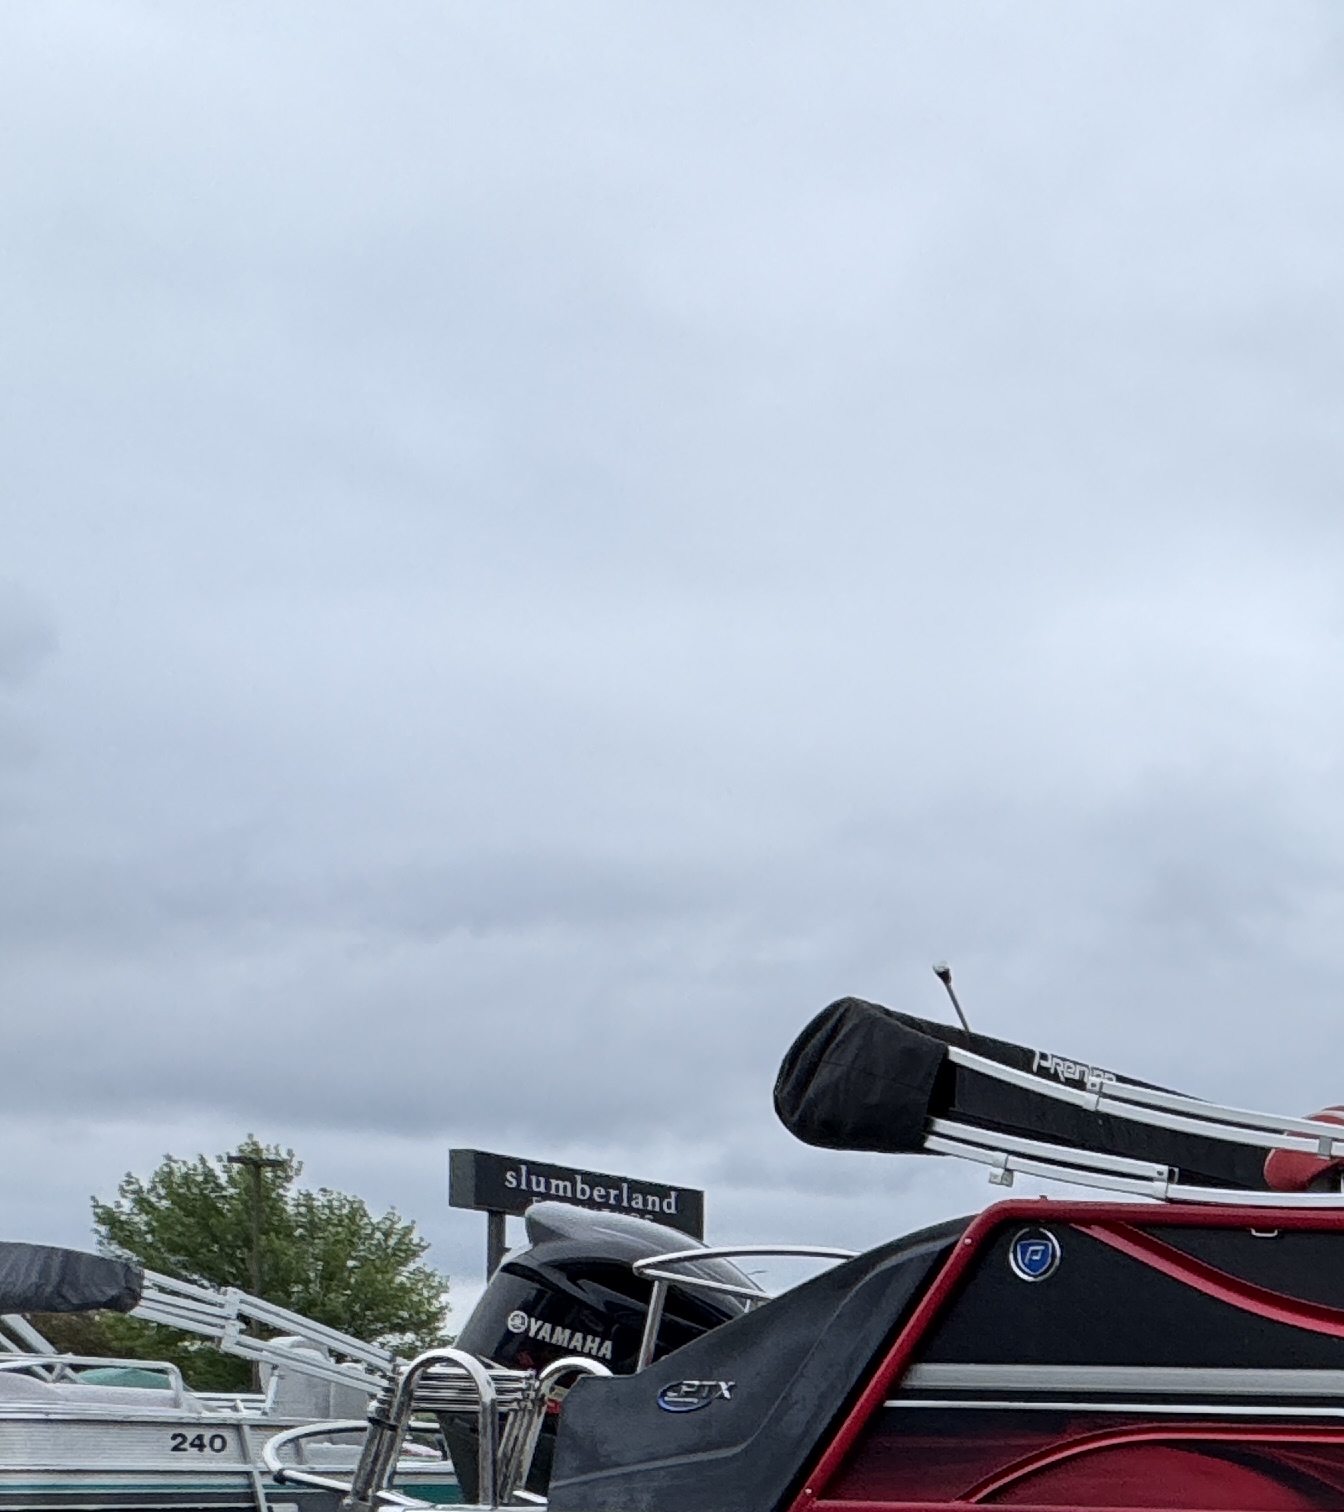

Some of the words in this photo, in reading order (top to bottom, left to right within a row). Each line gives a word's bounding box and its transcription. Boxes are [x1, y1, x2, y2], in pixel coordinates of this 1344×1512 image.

[505, 1164, 678, 1215] slumberland
[528, 1317, 613, 1360] YAMAHA
[170, 1432, 228, 1454] 240
